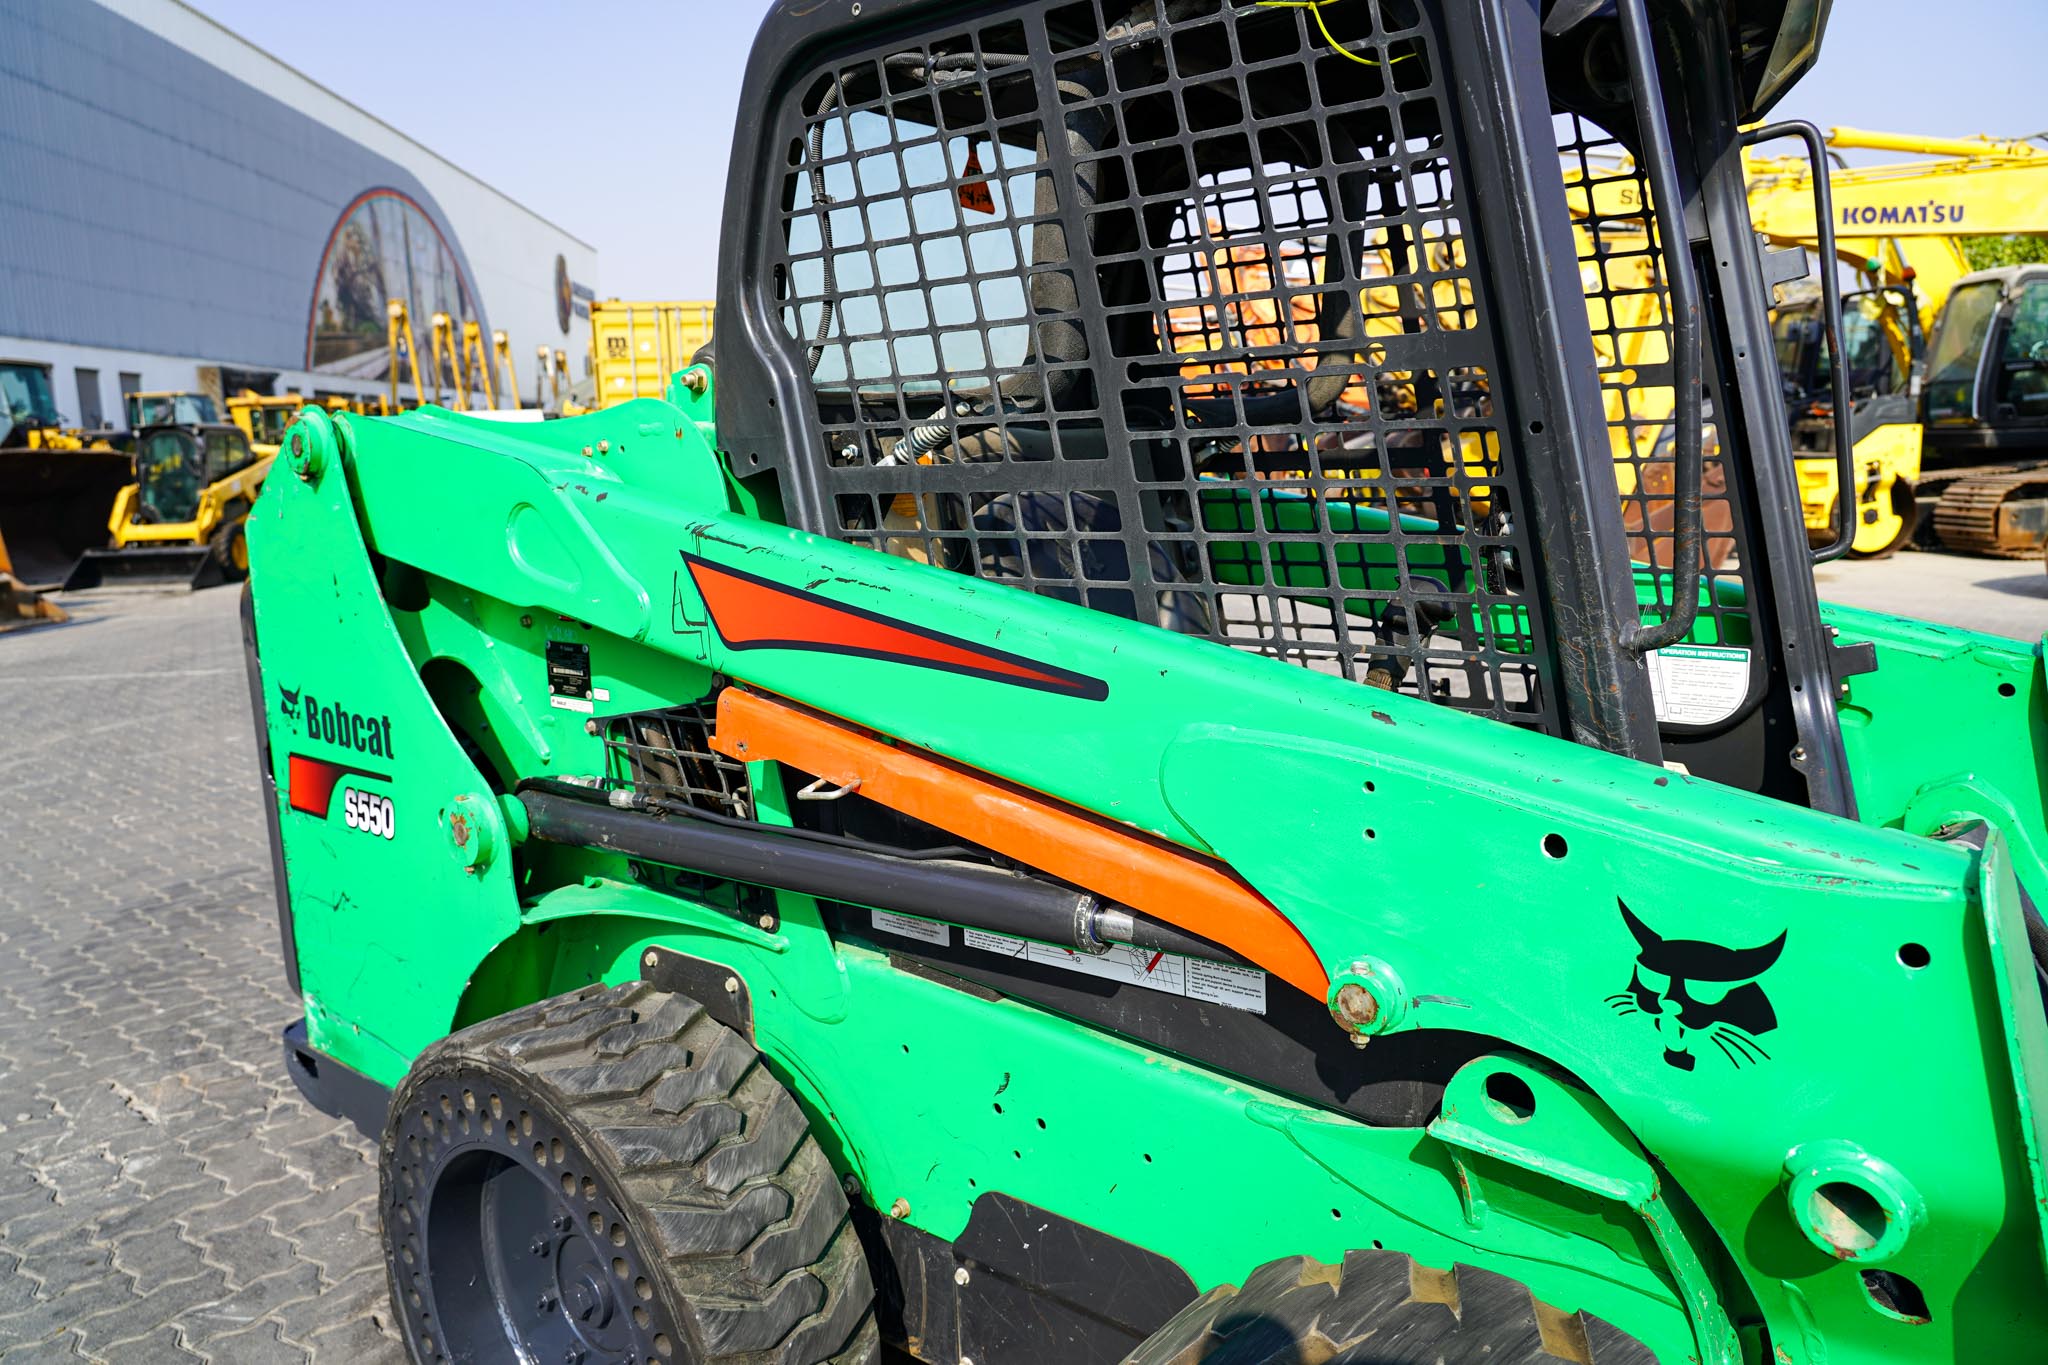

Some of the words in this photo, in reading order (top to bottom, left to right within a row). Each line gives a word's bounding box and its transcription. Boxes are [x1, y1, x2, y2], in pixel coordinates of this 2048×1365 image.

[1842, 200, 1964, 225] KOMATSU
[1698, 651, 1745, 659] INSTRUCTIONS
[304, 695, 394, 760] Bobcat
[345, 786, 395, 840] S550
